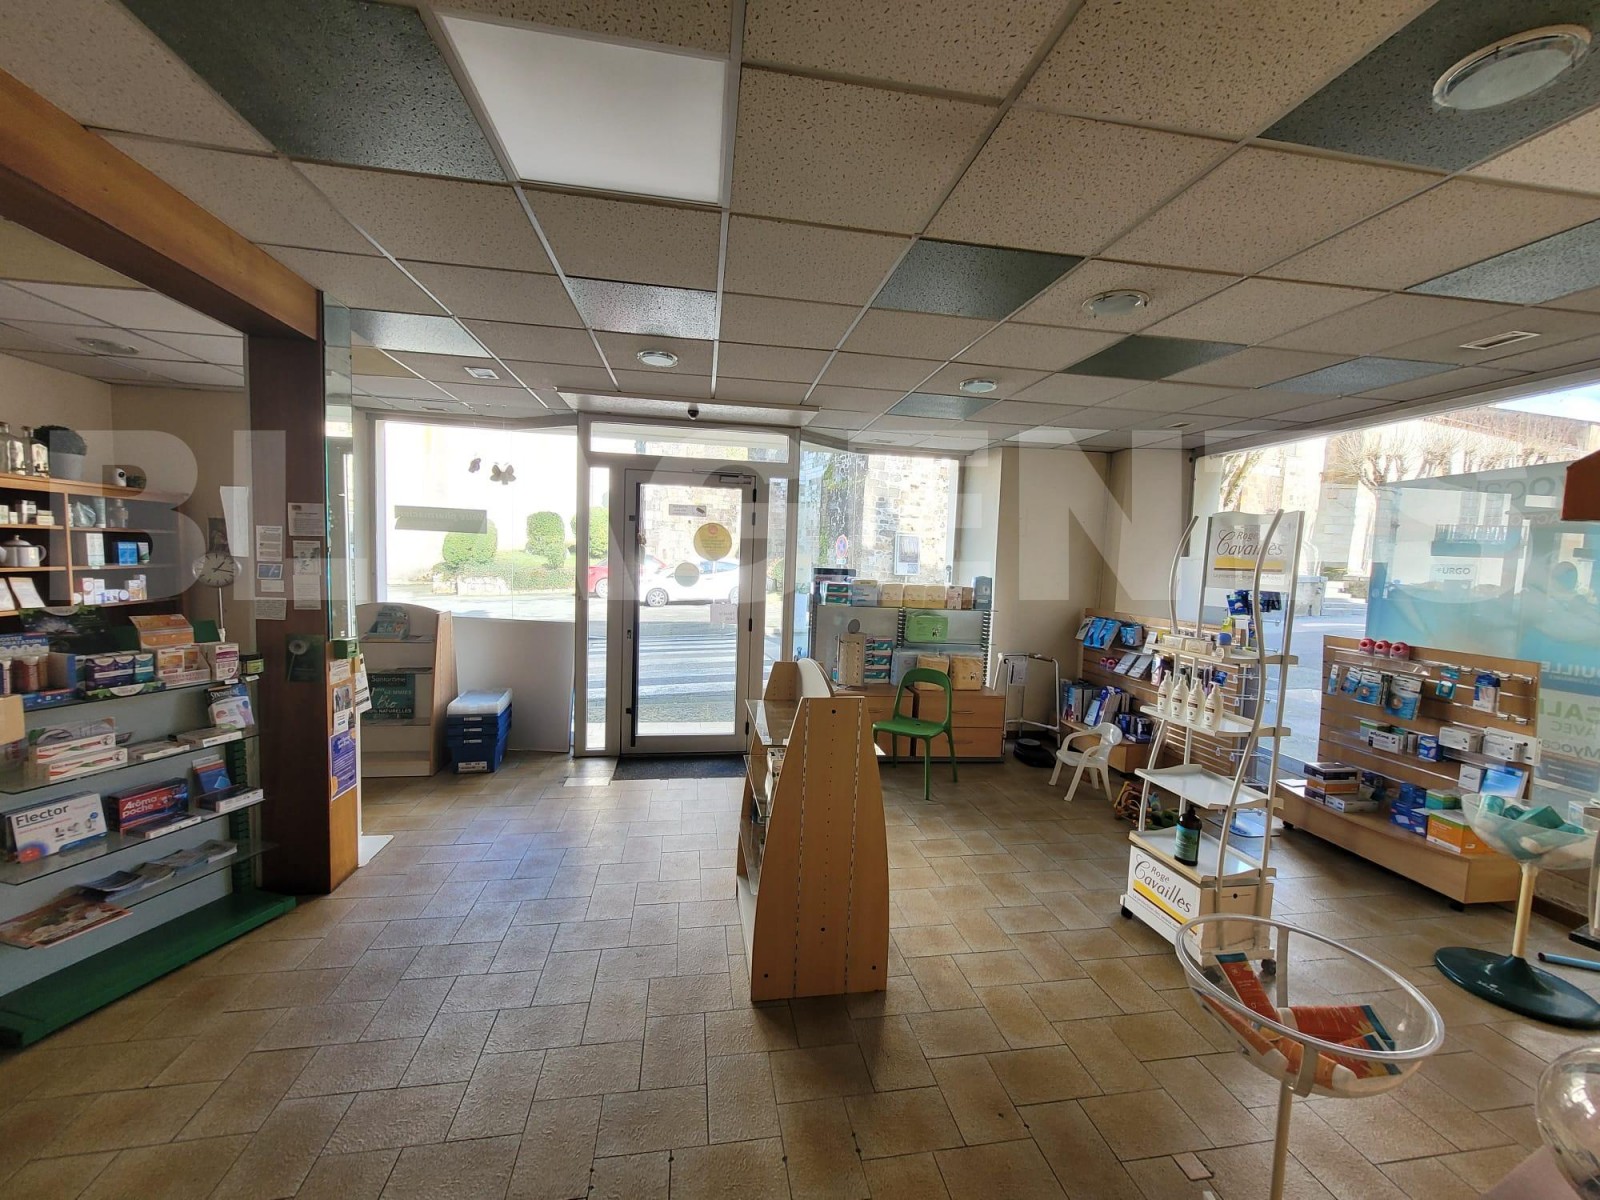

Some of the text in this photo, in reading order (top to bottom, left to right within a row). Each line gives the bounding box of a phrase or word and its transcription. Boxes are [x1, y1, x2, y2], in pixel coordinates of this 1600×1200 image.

[1442, 567, 1471, 575] URGO
[15, 804, 69, 827] Flector
[122, 803, 154, 819] poche
